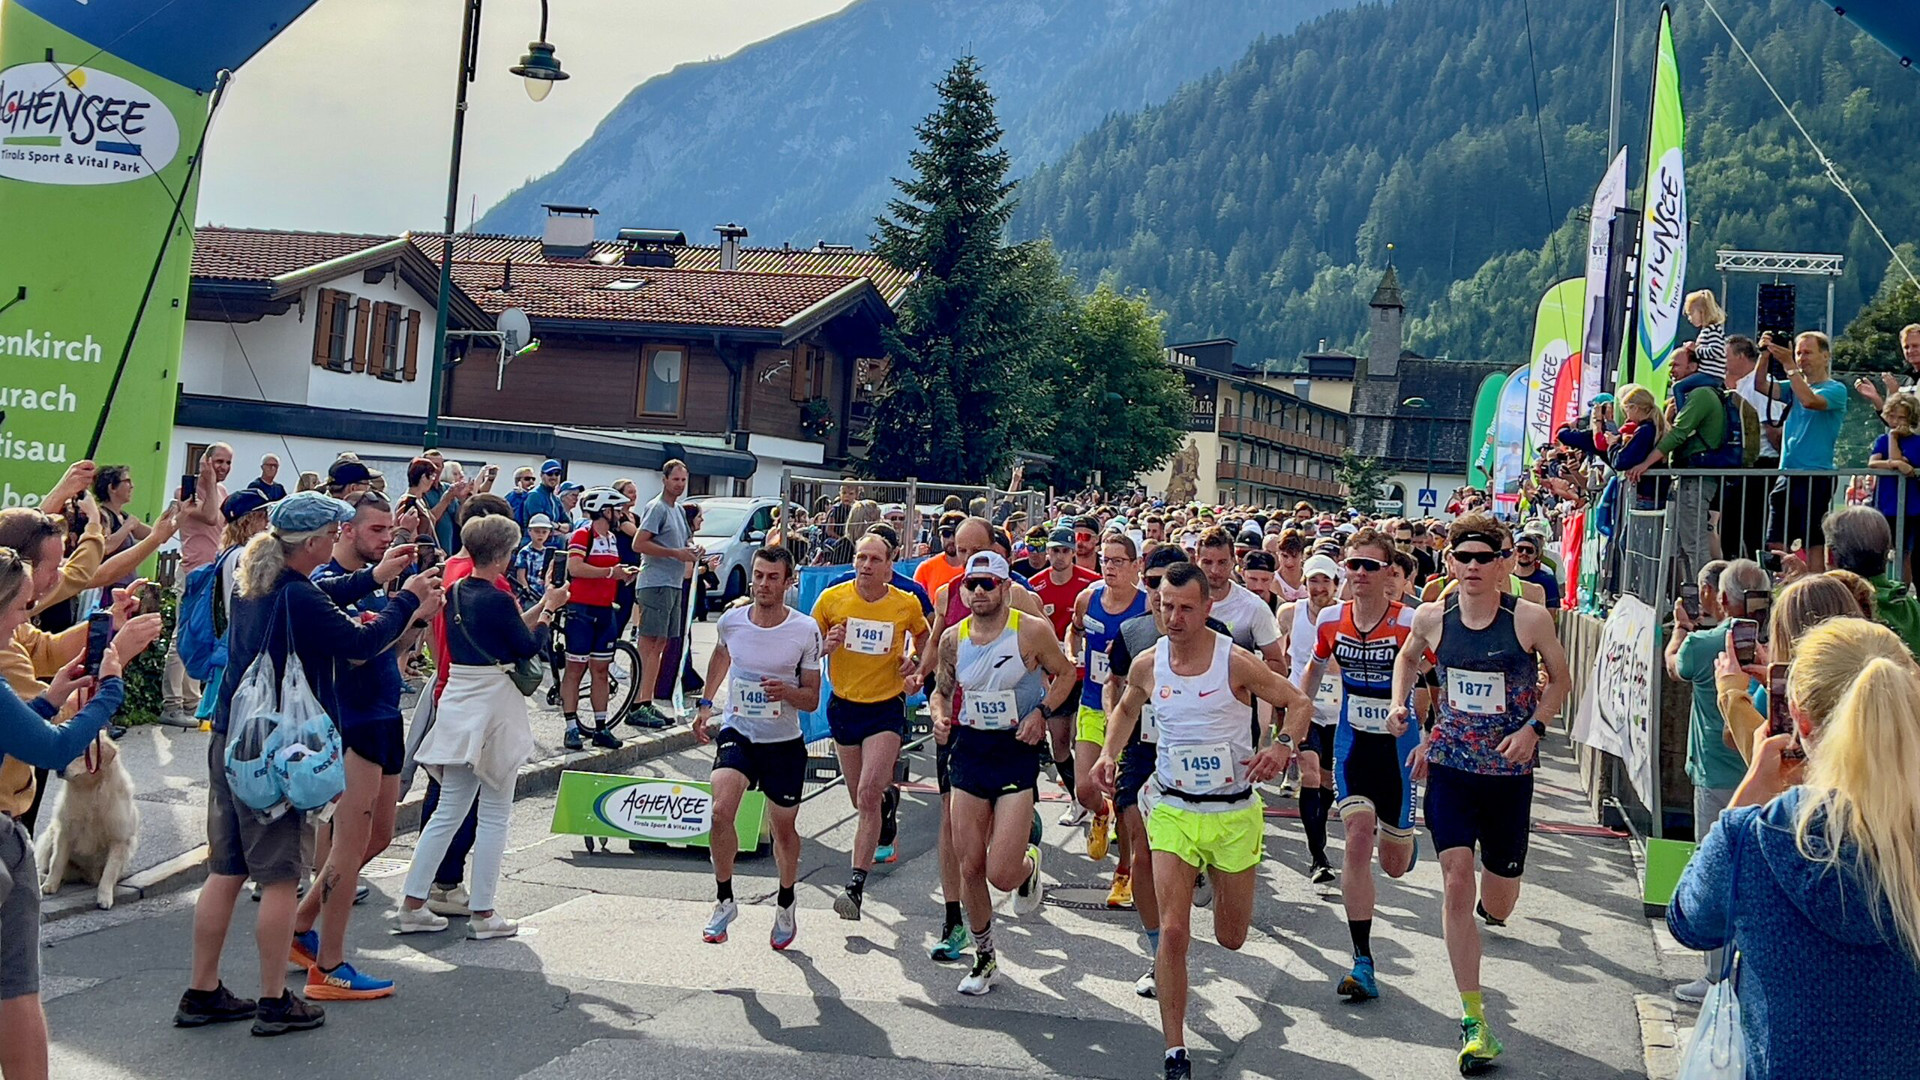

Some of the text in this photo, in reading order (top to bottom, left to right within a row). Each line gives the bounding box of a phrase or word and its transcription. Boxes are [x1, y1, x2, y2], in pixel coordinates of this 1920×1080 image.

[1, 149, 141, 174] Tirols Sport & Vital Park
[1531, 353, 1559, 436] ACHENSEE
[855, 627, 884, 642] 1481
[1098, 661, 1110, 673] 17
[1319, 683, 1334, 693] 52
[1457, 680, 1493, 697] 1877
[974, 701, 1007, 714] 1533
[1356, 706, 1389, 720] 1810
[1181, 756, 1221, 772] 1459
[620, 788, 708, 821] ACHENSEE
[634, 820, 649, 828] Tirols
[650, 823, 666, 831] Sport
[324, 975, 351, 988] HOKA
